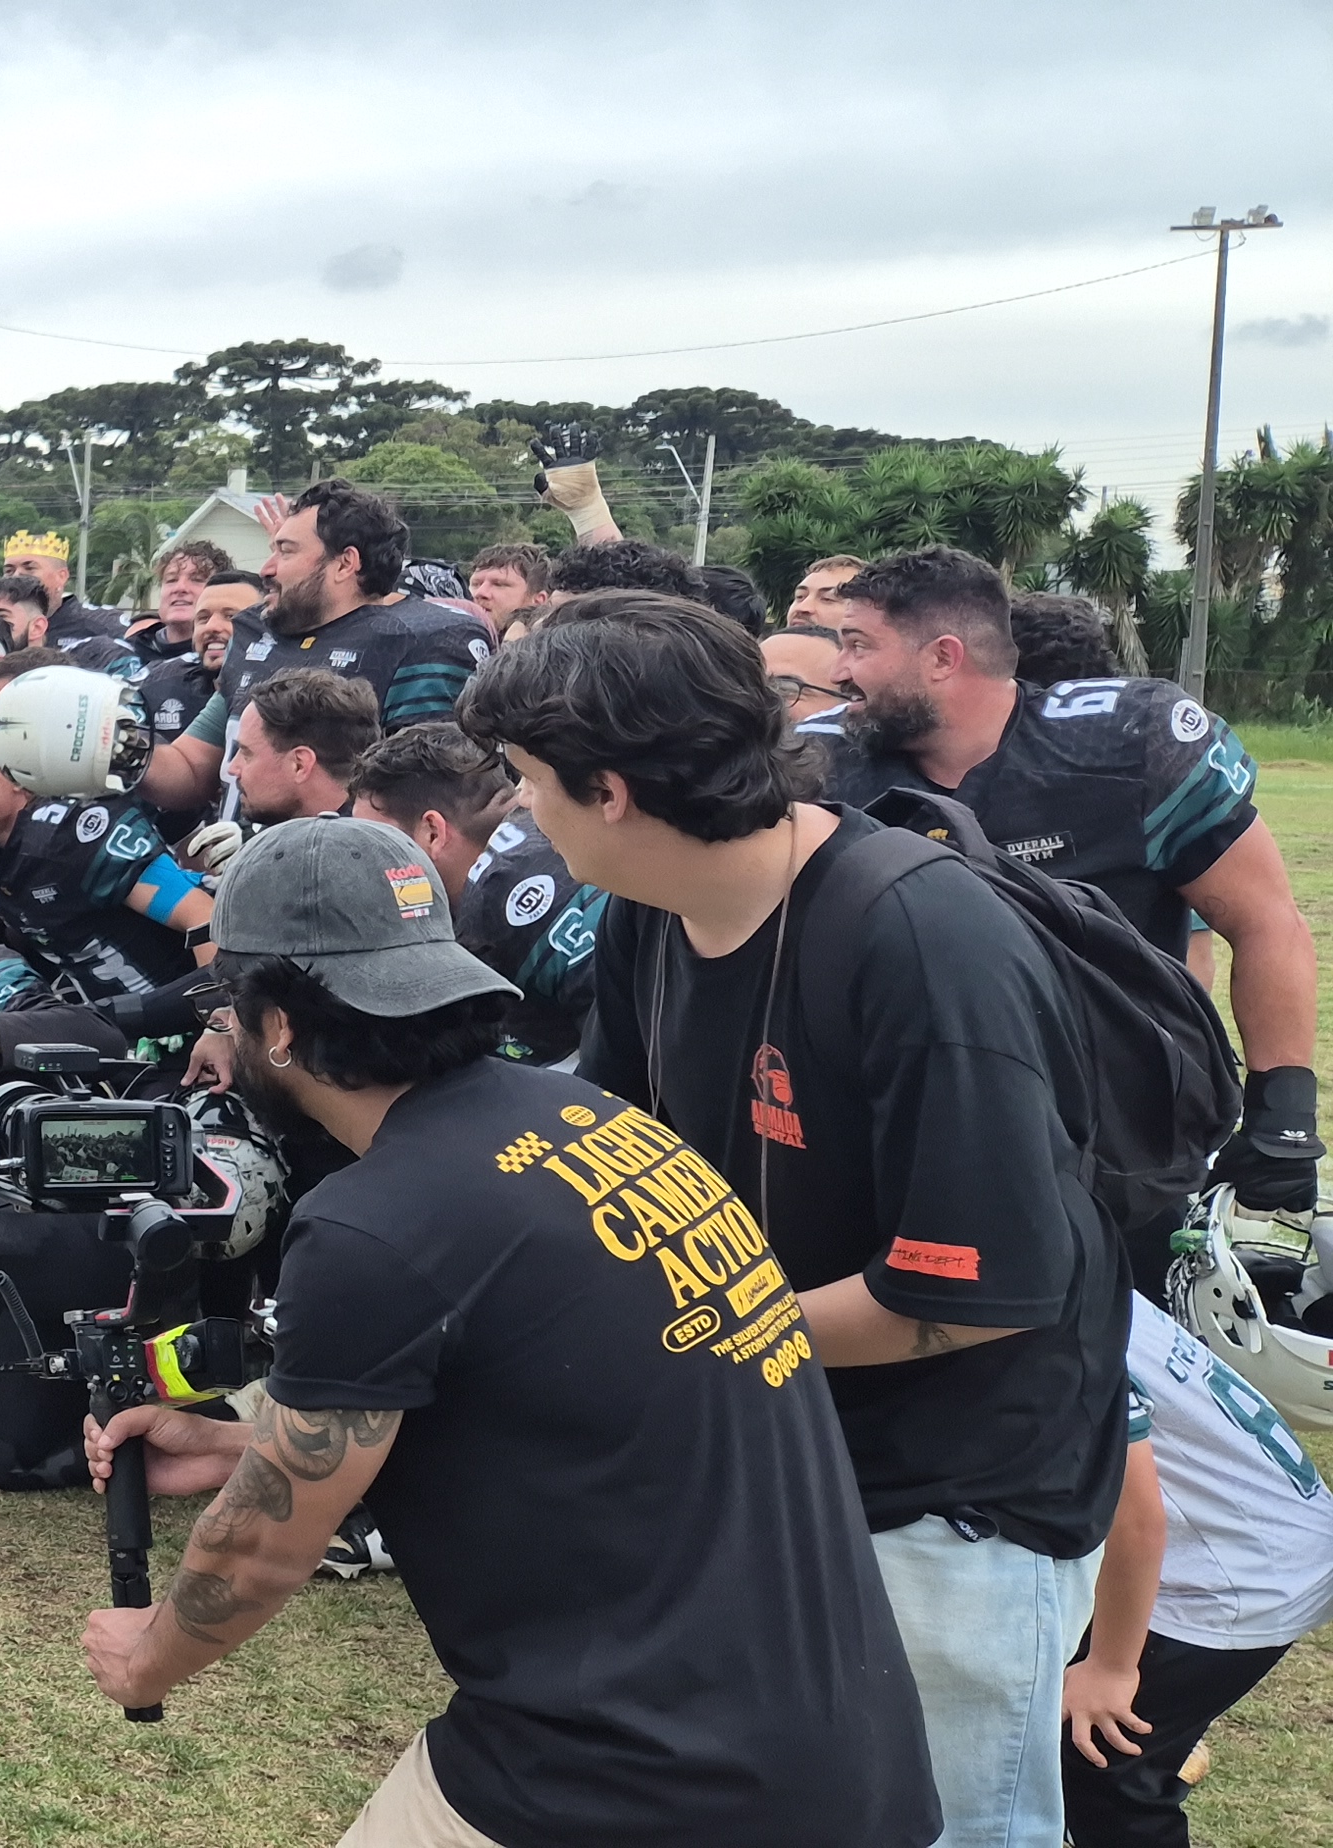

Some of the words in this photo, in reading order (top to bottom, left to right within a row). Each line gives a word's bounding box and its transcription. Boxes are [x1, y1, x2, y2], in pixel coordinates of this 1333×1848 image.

[1006, 835, 1065, 854] OVERALL
[1021, 850, 1055, 863] GYM
[541, 1106, 683, 1207] LIGHTS
[592, 1149, 732, 1263] CAMER
[655, 1197, 769, 1310] ACTIO
[673, 1313, 712, 1345] ESTD
[709, 1337, 735, 1358] THE
[734, 1321, 760, 1348] SILVER
[732, 1350, 744, 1365] A
[742, 1338, 766, 1361] STORY
